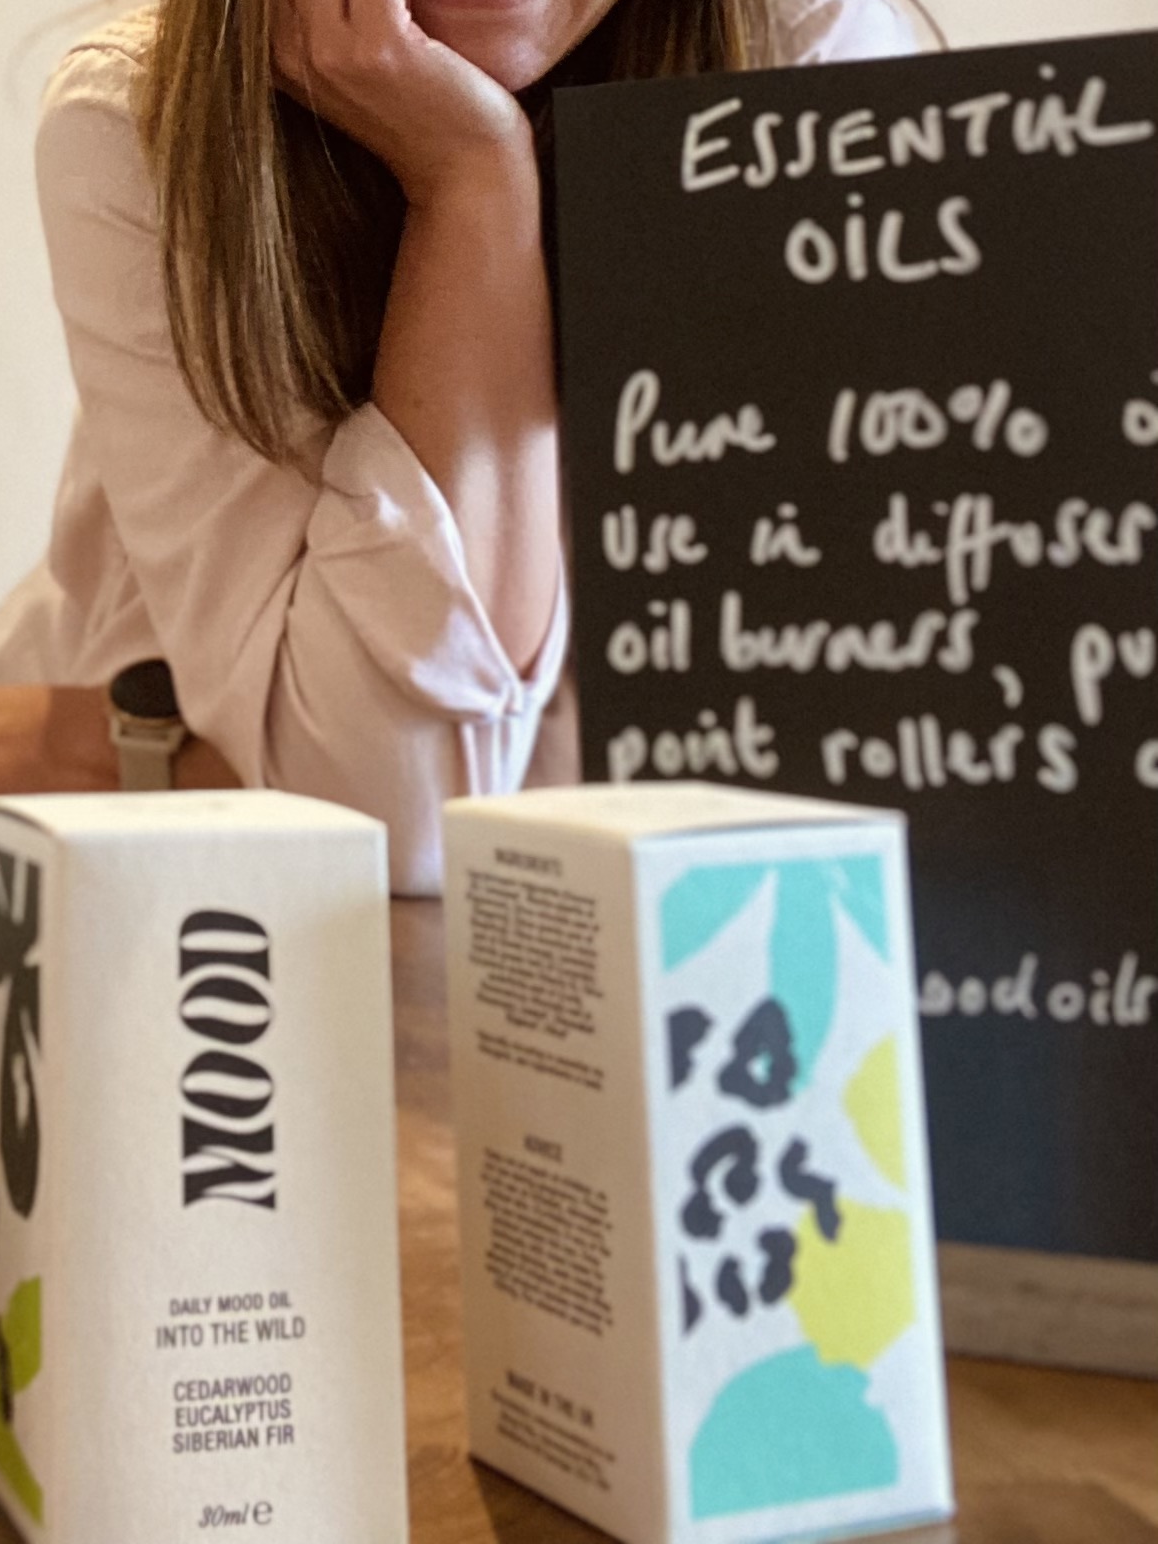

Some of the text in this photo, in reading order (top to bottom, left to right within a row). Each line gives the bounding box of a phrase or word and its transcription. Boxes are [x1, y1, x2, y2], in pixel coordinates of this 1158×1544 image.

[614, 369, 776, 473] Pure
[828, 379, 1047, 462] 100%
[750, 503, 821, 566] in
[607, 599, 691, 673] oil
[607, 696, 779, 780] point
[178, 909, 277, 1211] MOOD
[169, 1290, 293, 1317] DAILY MOOD OIL
[155, 1315, 307, 1349] INTO THE WILD
[173, 1372, 292, 1402] CEDARWOOD
[175, 1398, 292, 1428] EUCALYPTUS
[172, 1423, 295, 1454] SIBERIAN FIR
